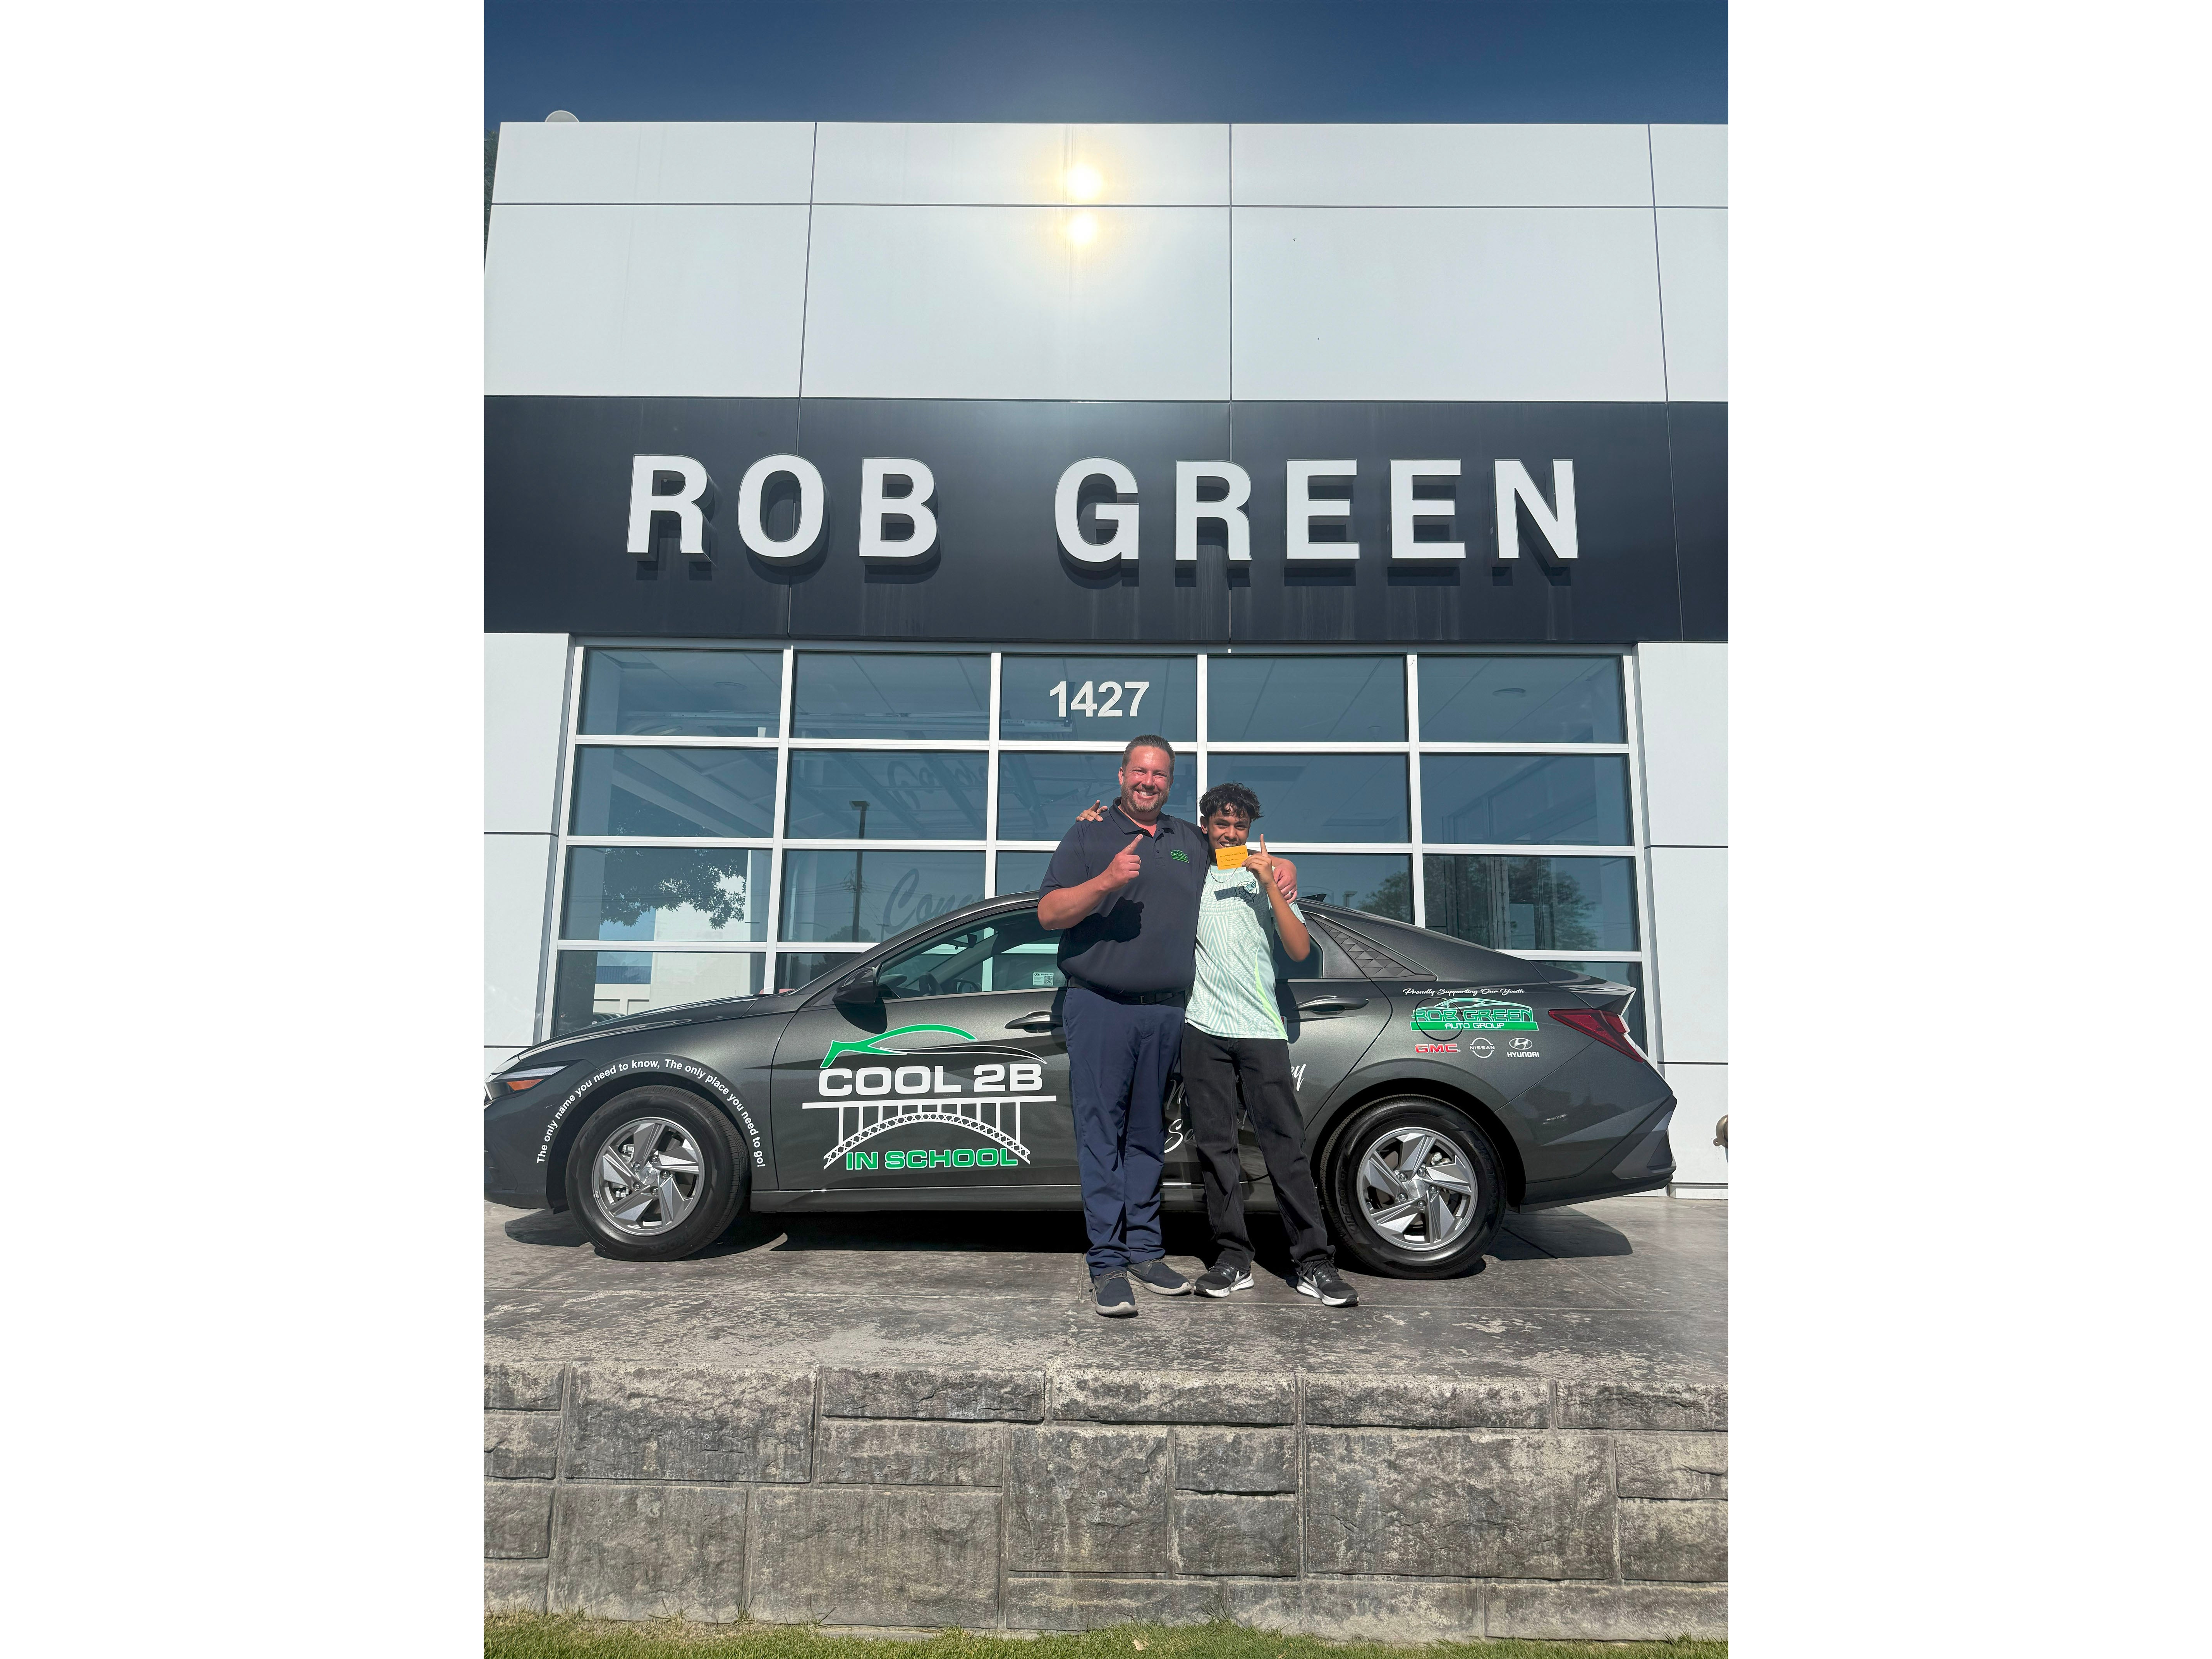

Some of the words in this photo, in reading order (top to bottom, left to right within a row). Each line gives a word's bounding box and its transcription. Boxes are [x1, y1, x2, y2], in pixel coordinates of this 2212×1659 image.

[626, 453, 938, 558] ROB
[1054, 457, 1580, 563] GREEN
[1050, 681, 1149, 717] 1427
[1402, 988, 1435, 997] Proudly
[1437, 988, 1478, 996] Supporting
[1412, 1009, 1460, 1022] ROB
[1463, 1009, 1534, 1022] GREEN
[1415, 1043, 1458, 1053] GMC
[618, 1063, 629, 1072] to
[632, 1060, 660, 1069] know,
[665, 1059, 683, 1070] The
[685, 1065, 706, 1079] only
[593, 1065, 617, 1082] need
[819, 1066, 962, 1096] COOL
[974, 1063, 1042, 1092] 2B
[575, 1080, 592, 1097] you
[705, 1075, 730, 1095] place
[555, 1095, 575, 1120] name
[726, 1093, 744, 1111] you
[544, 1120, 558, 1142] only
[740, 1111, 759, 1136] need
[752, 1137, 761, 1148] to
[536, 1144, 548, 1164] The
[754, 1151, 766, 1167] go!
[846, 1151, 879, 1170] IN
[884, 1148, 1018, 1169] SCHOOL
